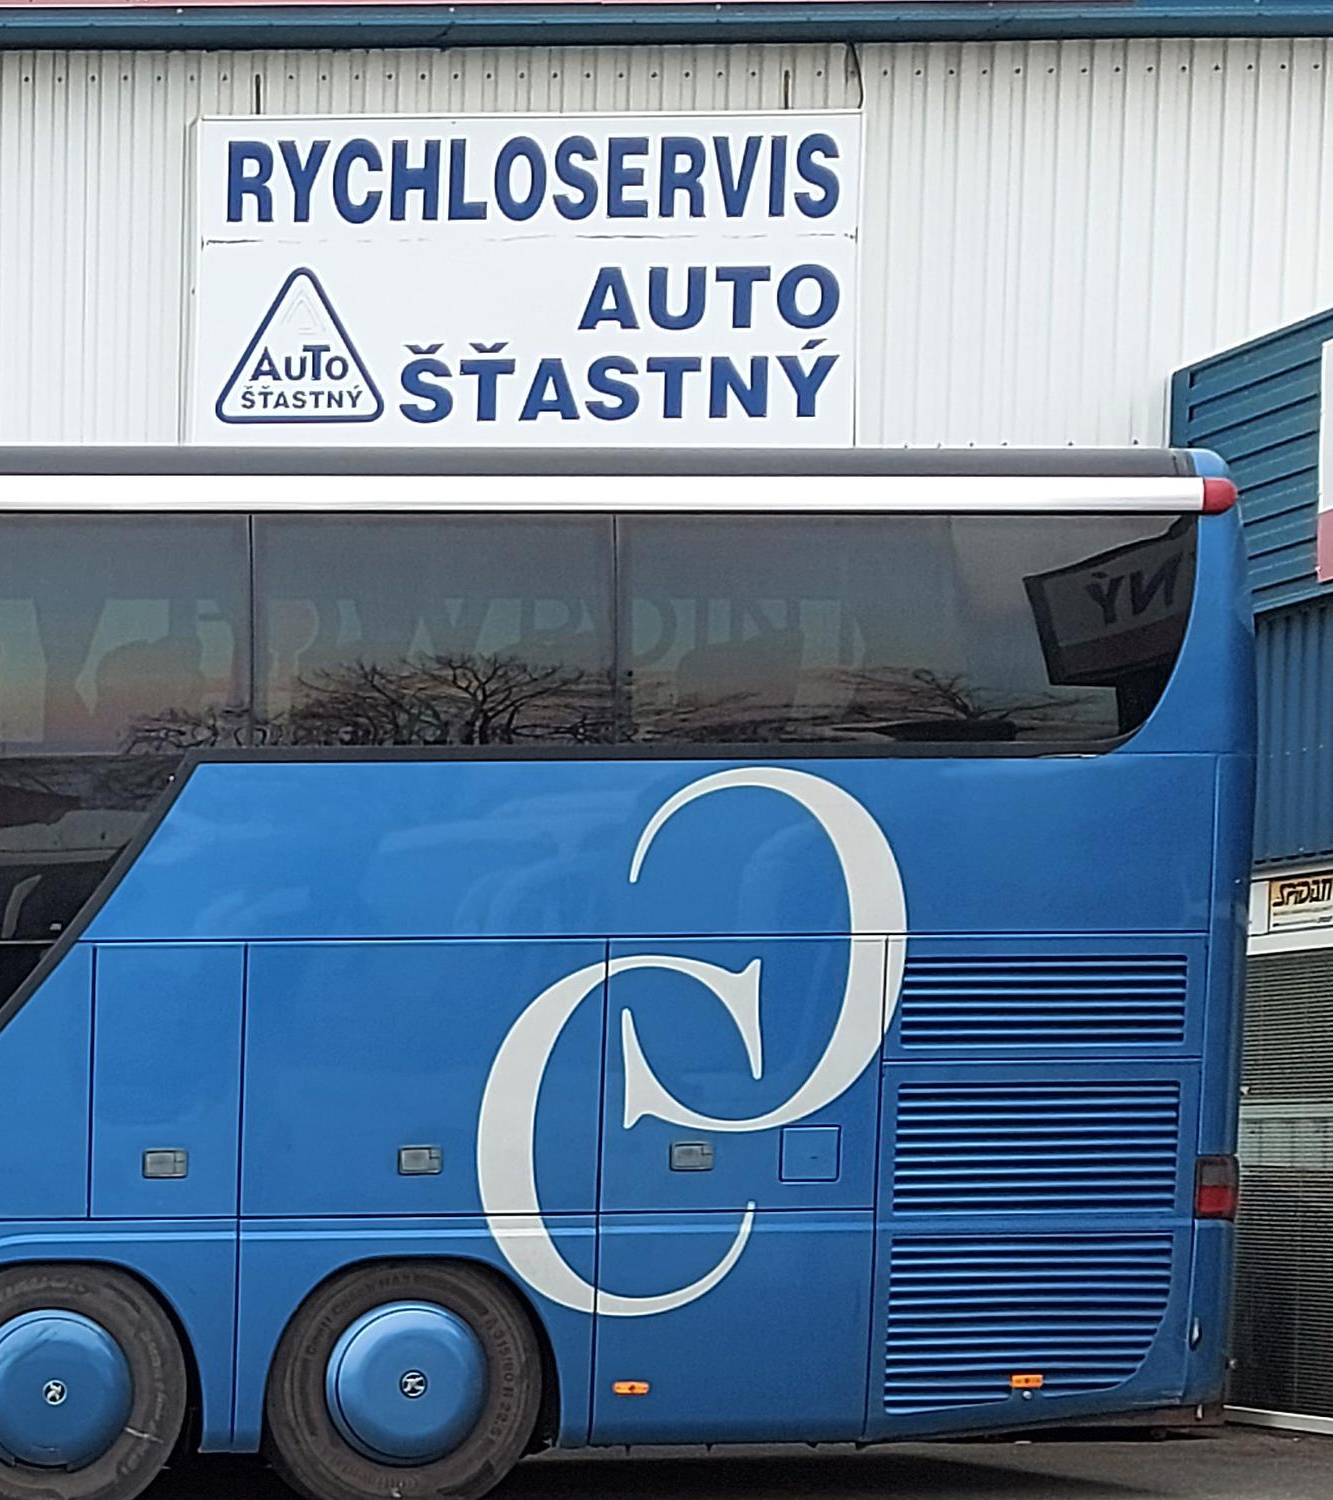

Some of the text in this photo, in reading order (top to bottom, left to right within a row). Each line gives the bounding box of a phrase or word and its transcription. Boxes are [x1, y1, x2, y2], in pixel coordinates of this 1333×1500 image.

[225, 133, 841, 225] RYCHLOSERVIS
[578, 263, 840, 331] AUTO
[241, 384, 363, 409] ŠŤASTNÝ
[399, 339, 841, 424] ŠŤASTNÝ
